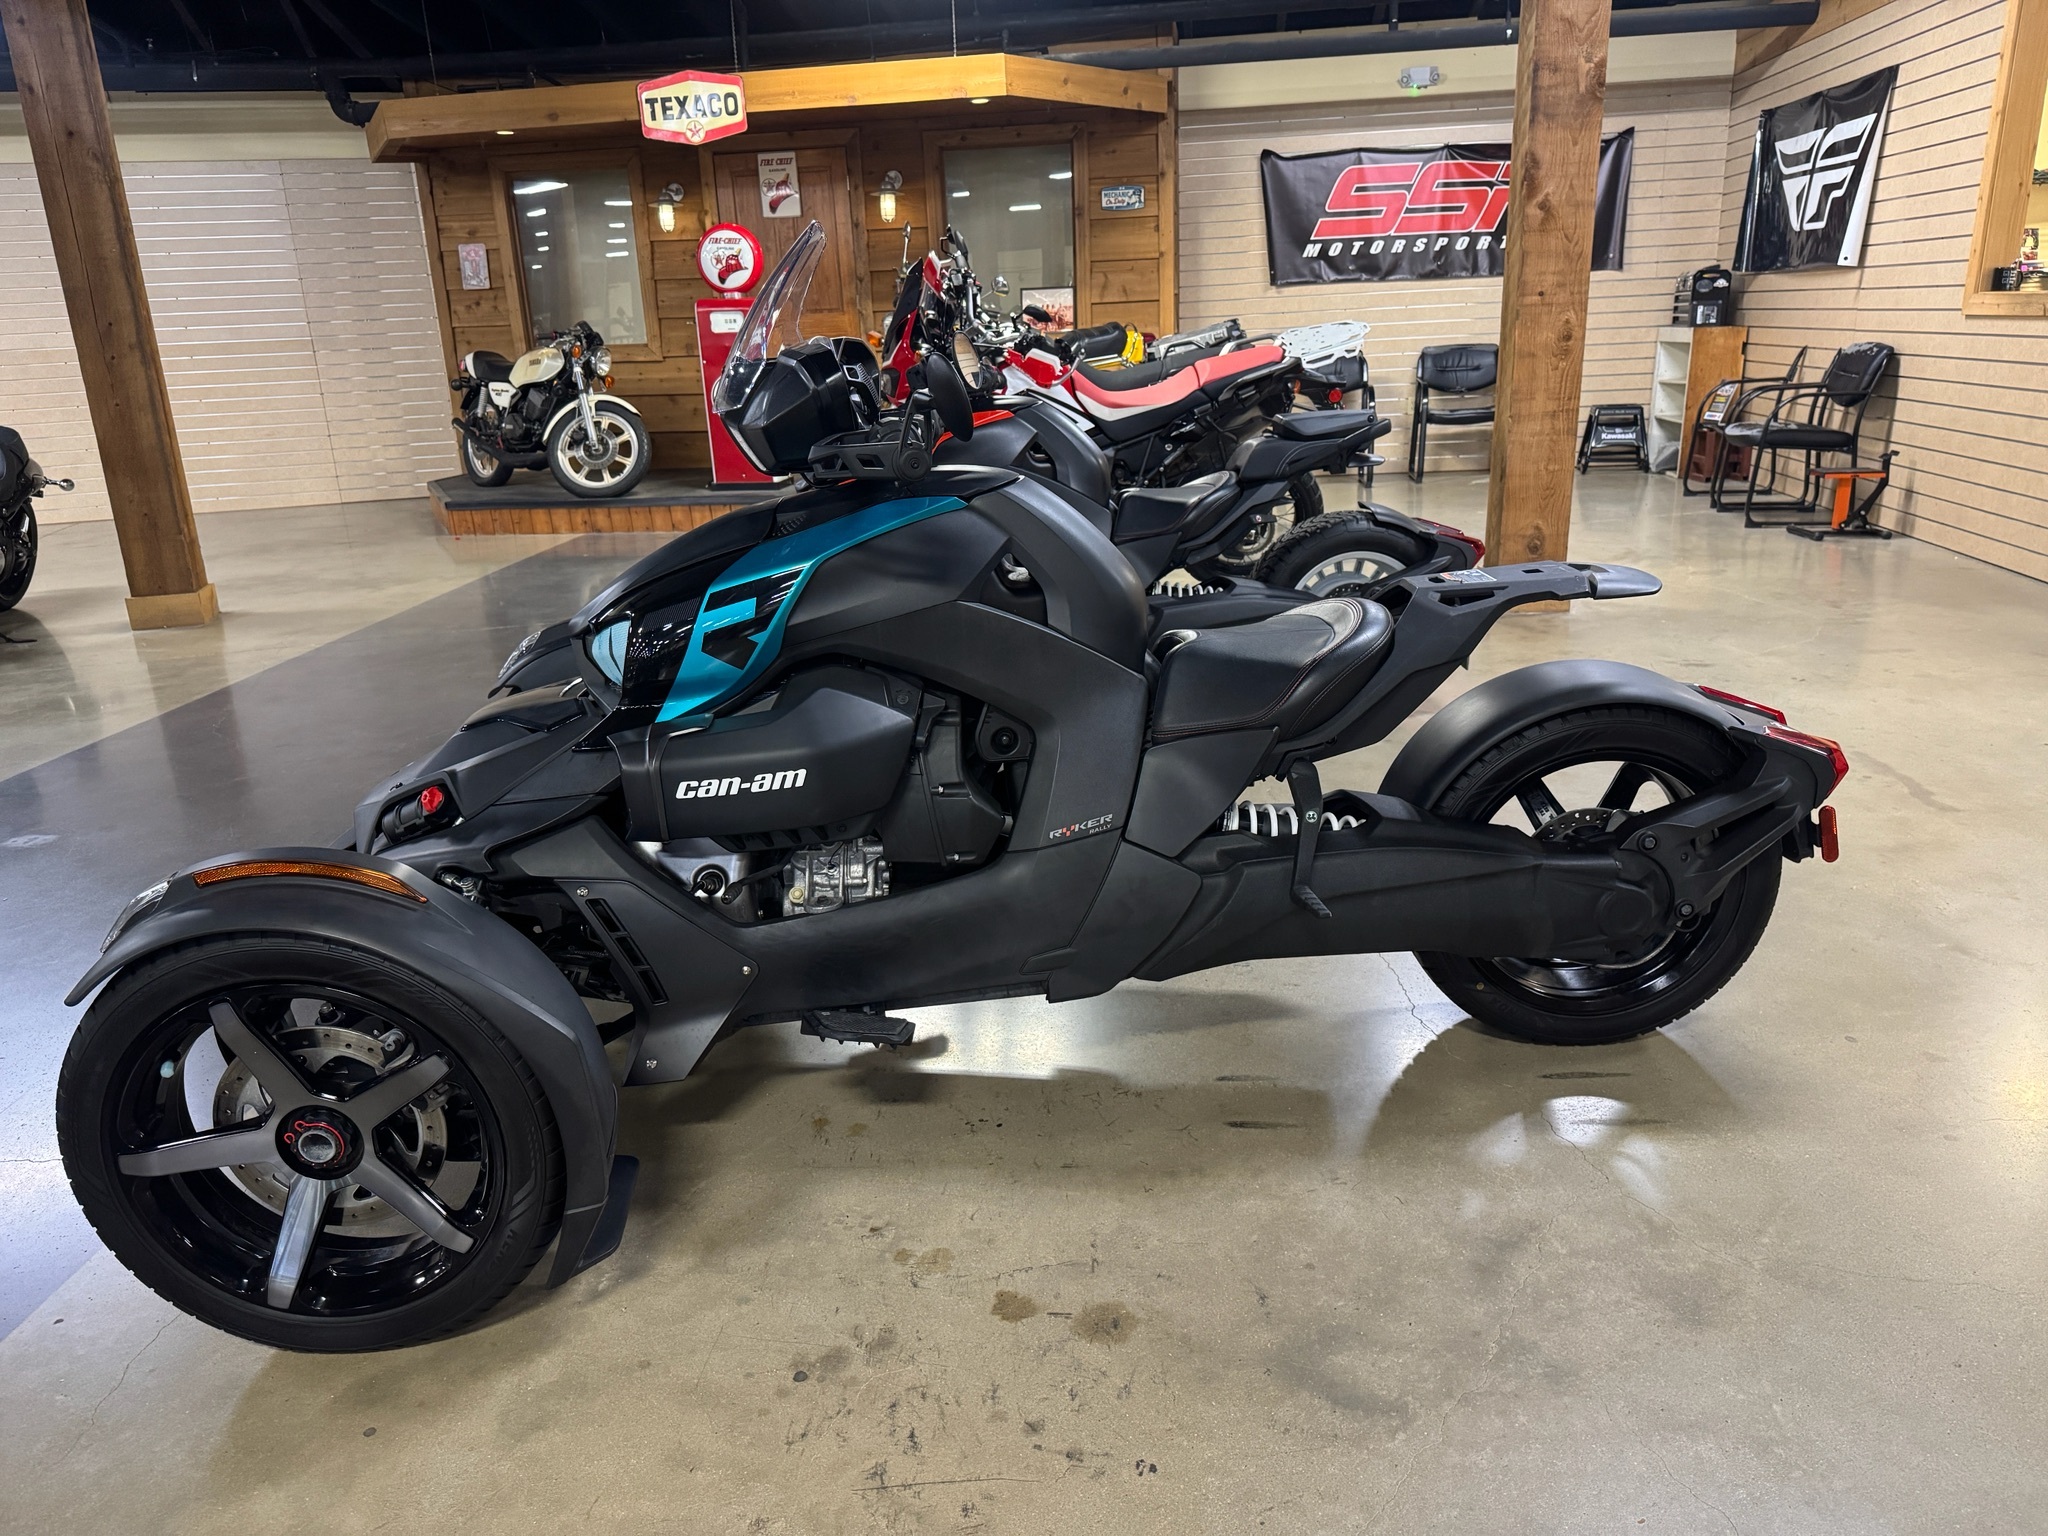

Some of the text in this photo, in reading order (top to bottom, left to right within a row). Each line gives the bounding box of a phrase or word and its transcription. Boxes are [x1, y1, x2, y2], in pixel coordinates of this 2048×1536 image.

[645, 92, 739, 121] TEXACO
[760, 157, 794, 166] FIRE CHIEF
[675, 768, 807, 799] can-am
[1049, 813, 1113, 839] RYKER
[1089, 823, 1112, 834] RALLY
